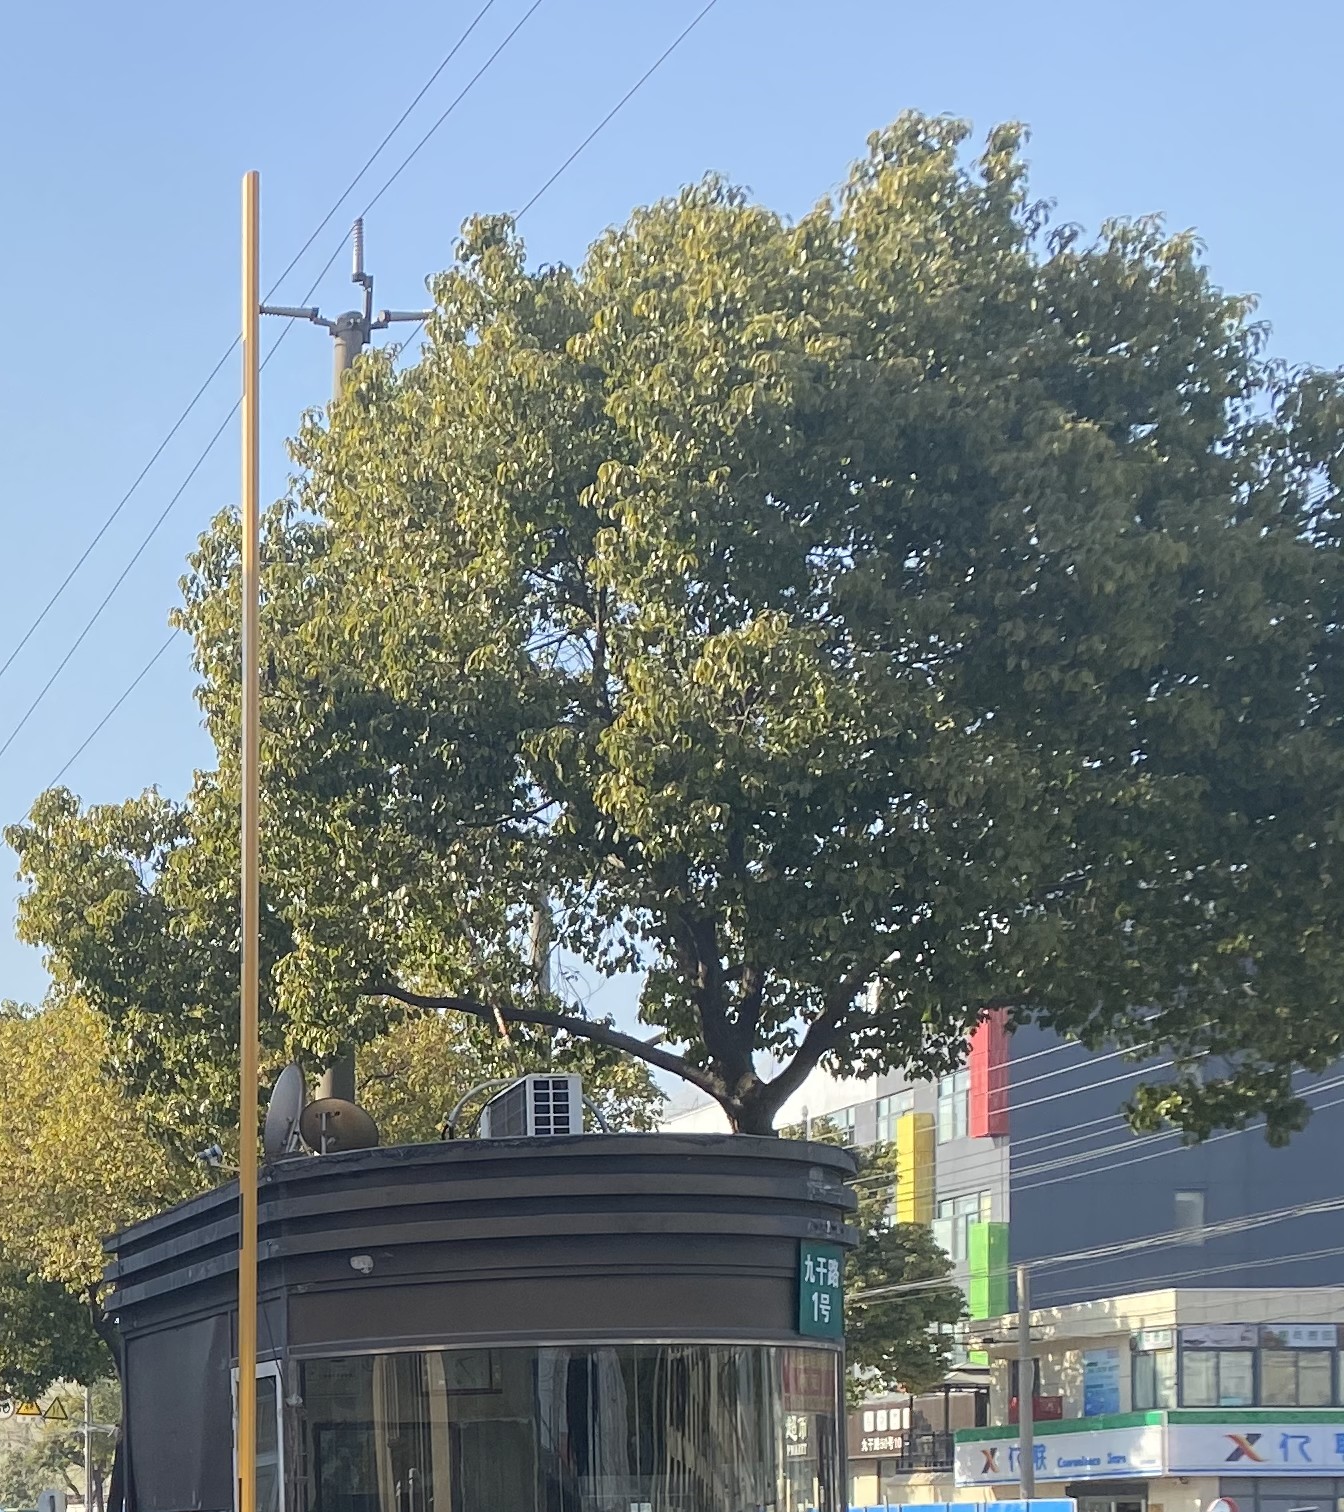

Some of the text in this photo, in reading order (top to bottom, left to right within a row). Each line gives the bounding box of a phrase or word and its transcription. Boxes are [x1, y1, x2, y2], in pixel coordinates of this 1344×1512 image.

[804, 1253, 840, 1288] 九干路
[812, 1291, 832, 1323] 1号
